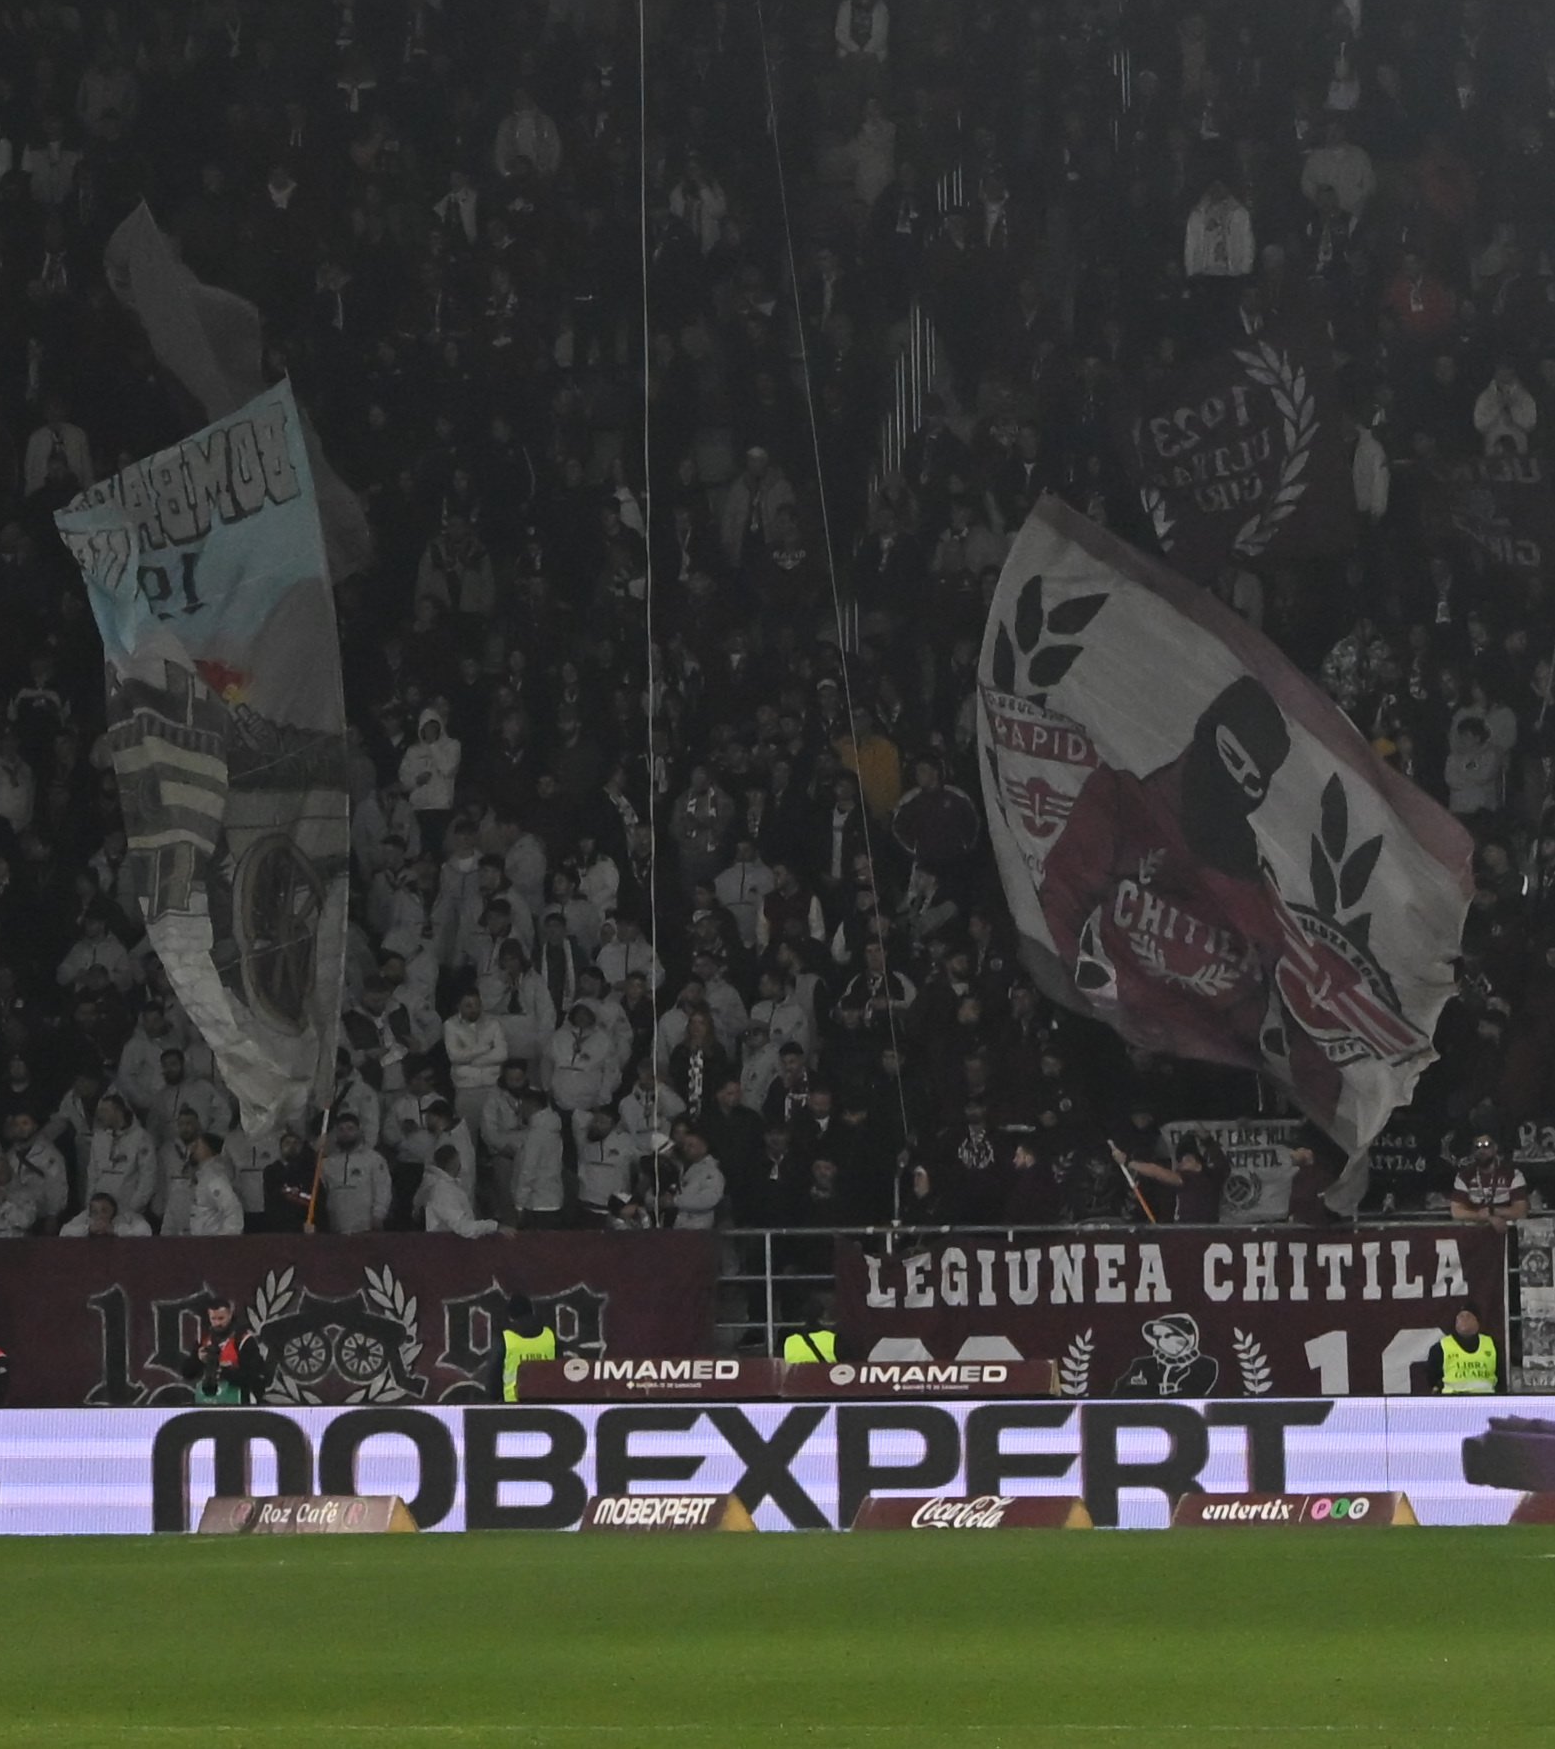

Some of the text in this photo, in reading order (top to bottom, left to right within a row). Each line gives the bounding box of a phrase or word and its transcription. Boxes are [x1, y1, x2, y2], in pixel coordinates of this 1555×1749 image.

[864, 1237, 1470, 1308] LEGIUNEA CHITILA
[593, 1359, 740, 1381] IMAMED
[859, 1363, 1007, 1384] IMAMED
[152, 1399, 1334, 1532] MOBEXPERT
[258, 1503, 292, 1524] Roz
[296, 1501, 339, 1524] Café
[593, 1497, 717, 1526] MOBEXPERT
[1201, 1498, 1293, 1521] entertix
